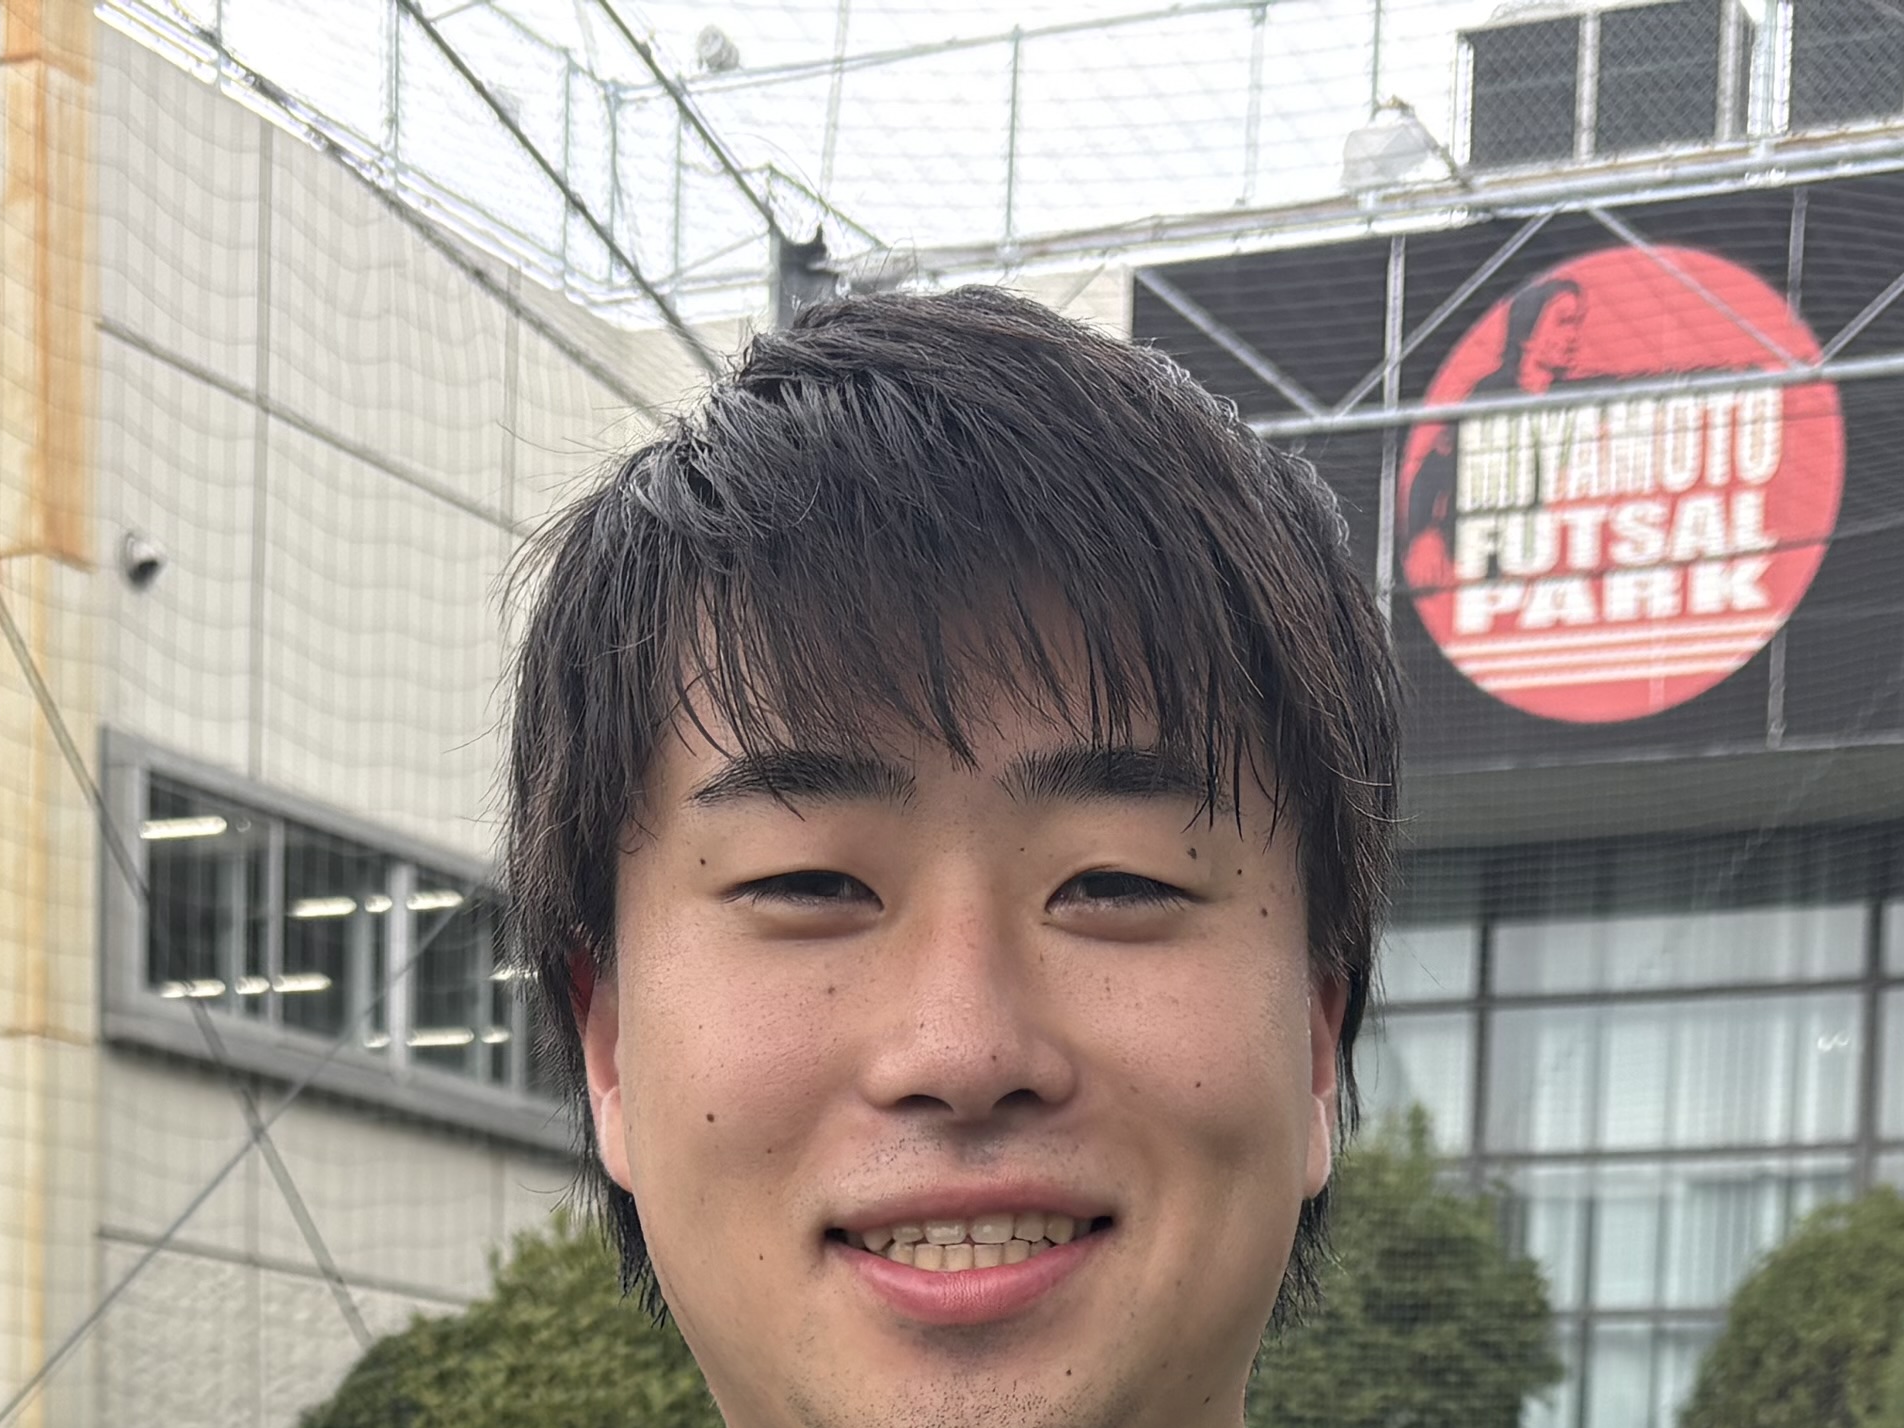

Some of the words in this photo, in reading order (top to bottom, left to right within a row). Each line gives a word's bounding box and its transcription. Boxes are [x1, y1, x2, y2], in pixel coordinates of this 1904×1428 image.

[1455, 385, 1785, 514] MIYAMOTO
[1453, 488, 1780, 581] FUTSAL
[1452, 556, 1776, 635] PARK
